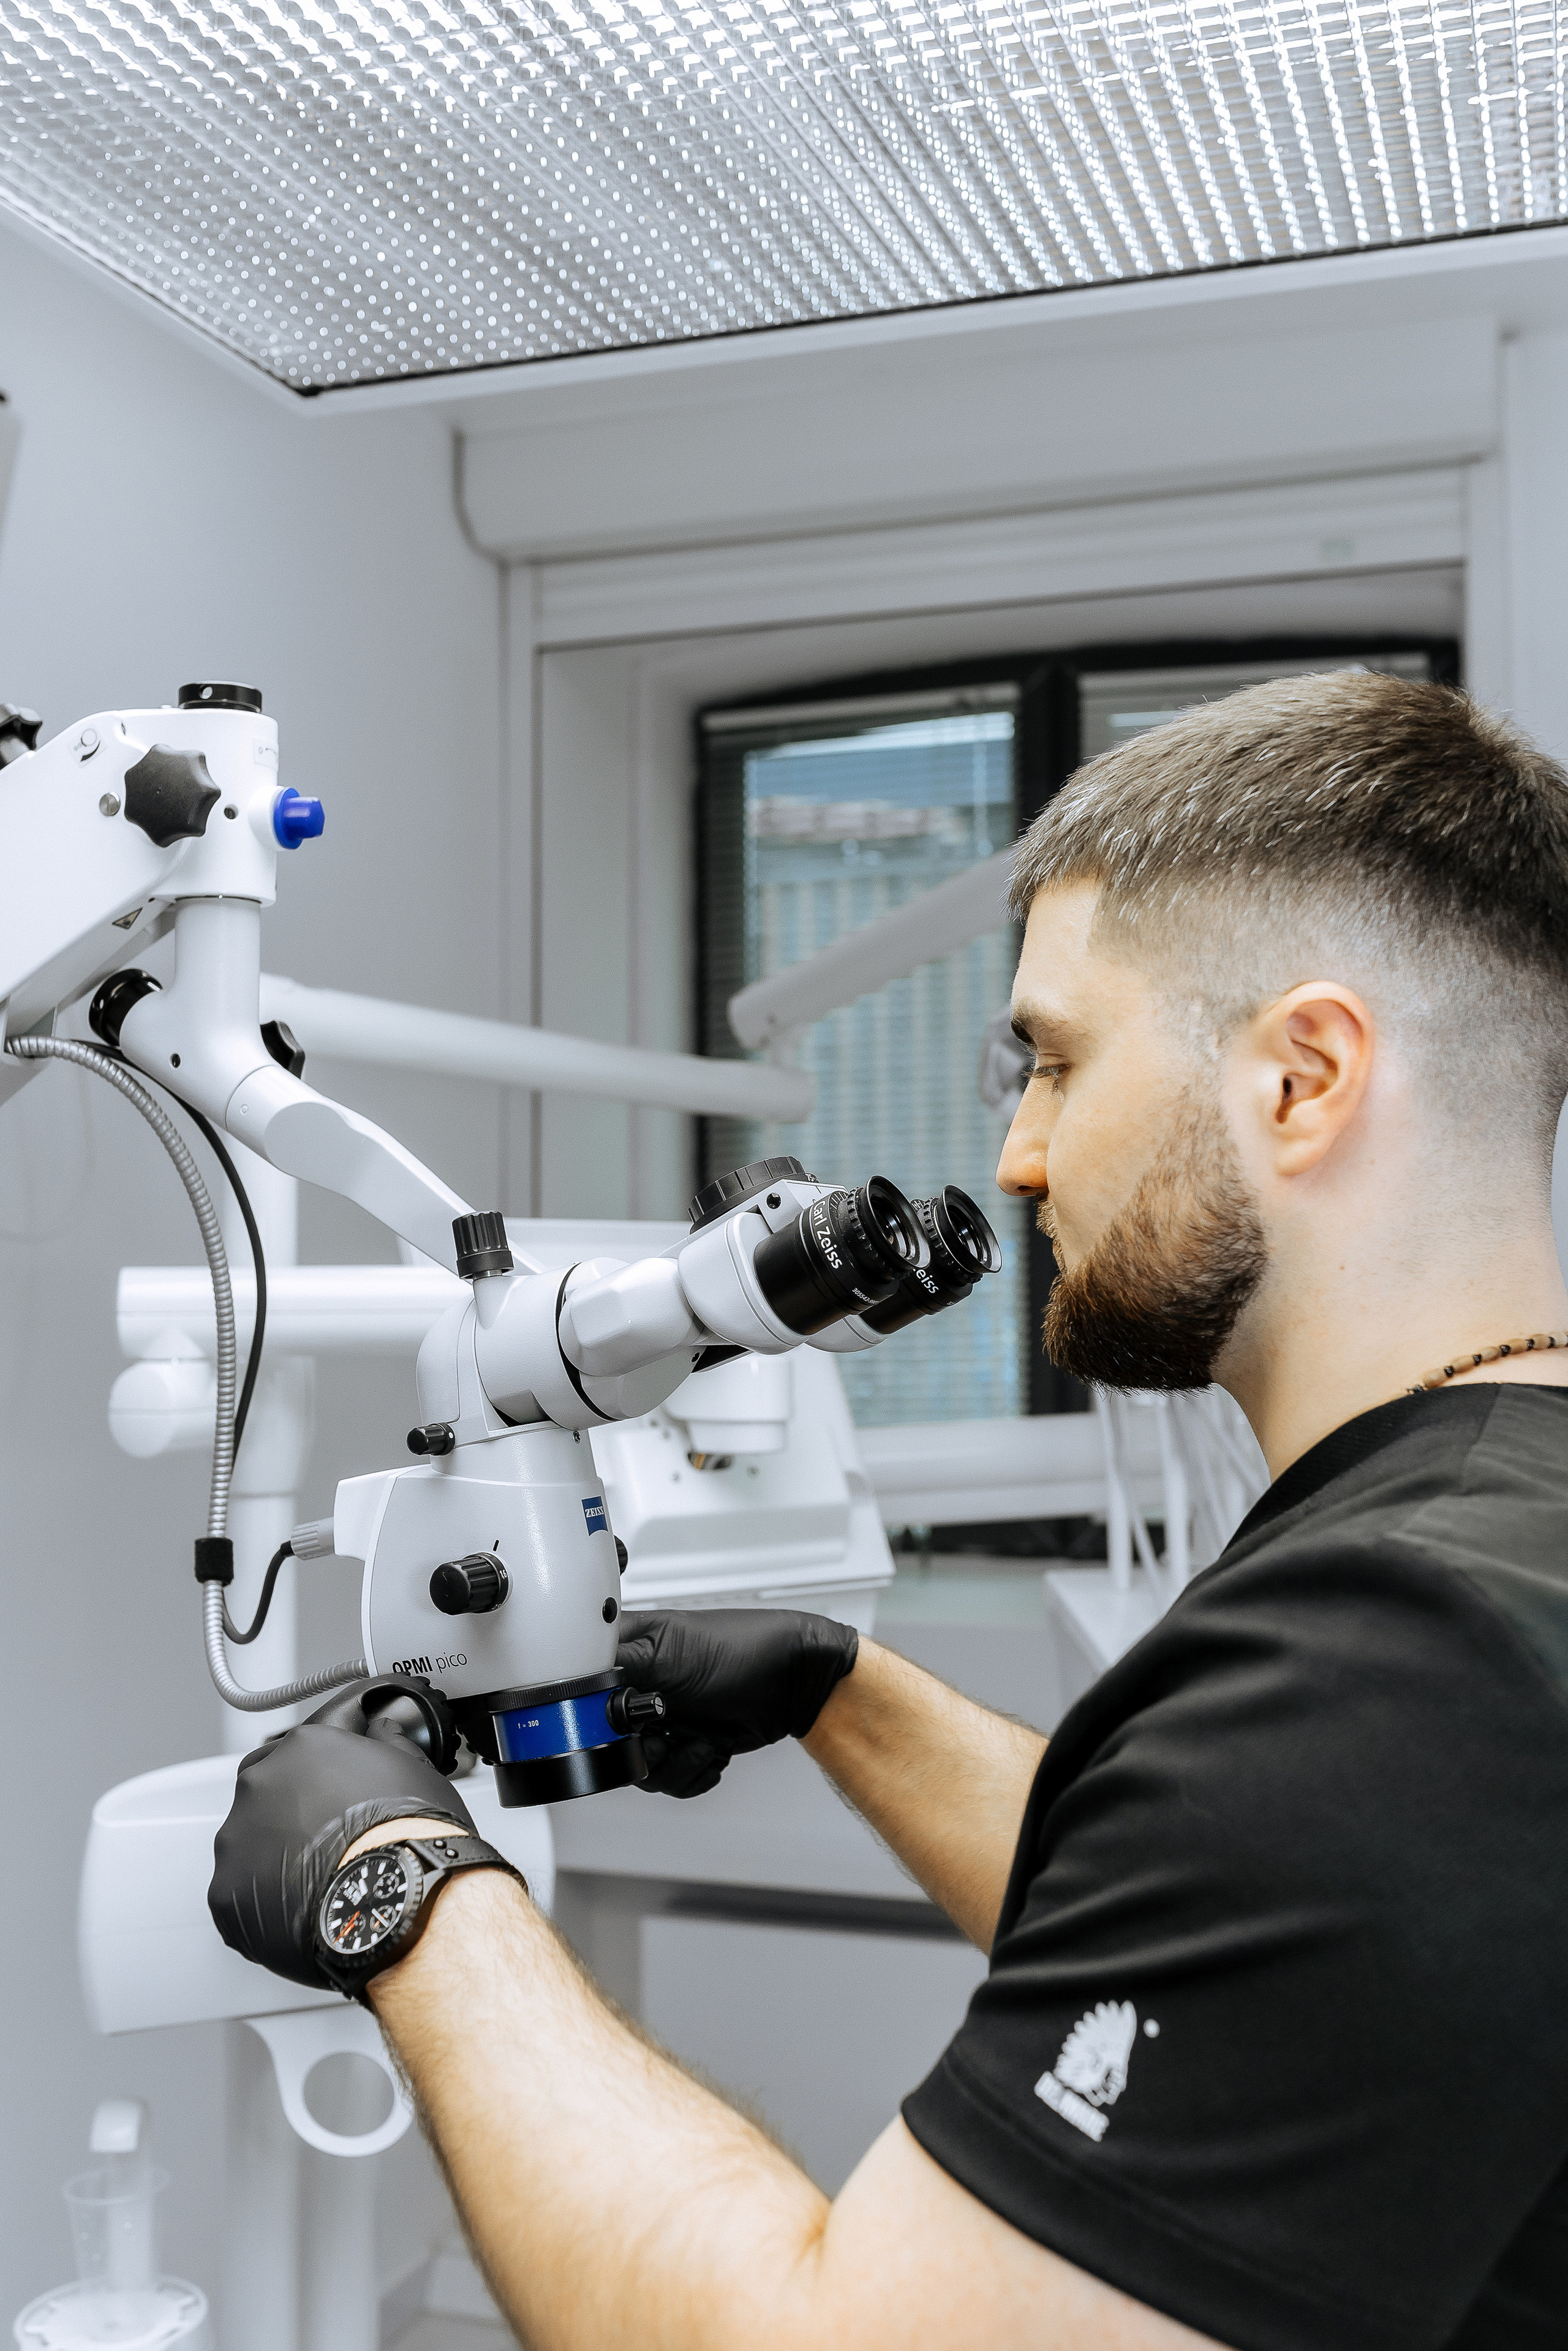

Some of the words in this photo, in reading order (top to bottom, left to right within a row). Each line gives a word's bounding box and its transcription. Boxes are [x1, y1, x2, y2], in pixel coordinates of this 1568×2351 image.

[813, 1201, 827, 1226] Carl
[816, 1226, 843, 1269] Zeiss
[913, 1268, 940, 1294] eiss
[585, 1506, 605, 1518] ZEISS
[392, 1656, 433, 1674] OPMI
[435, 1651, 467, 1674] pico
